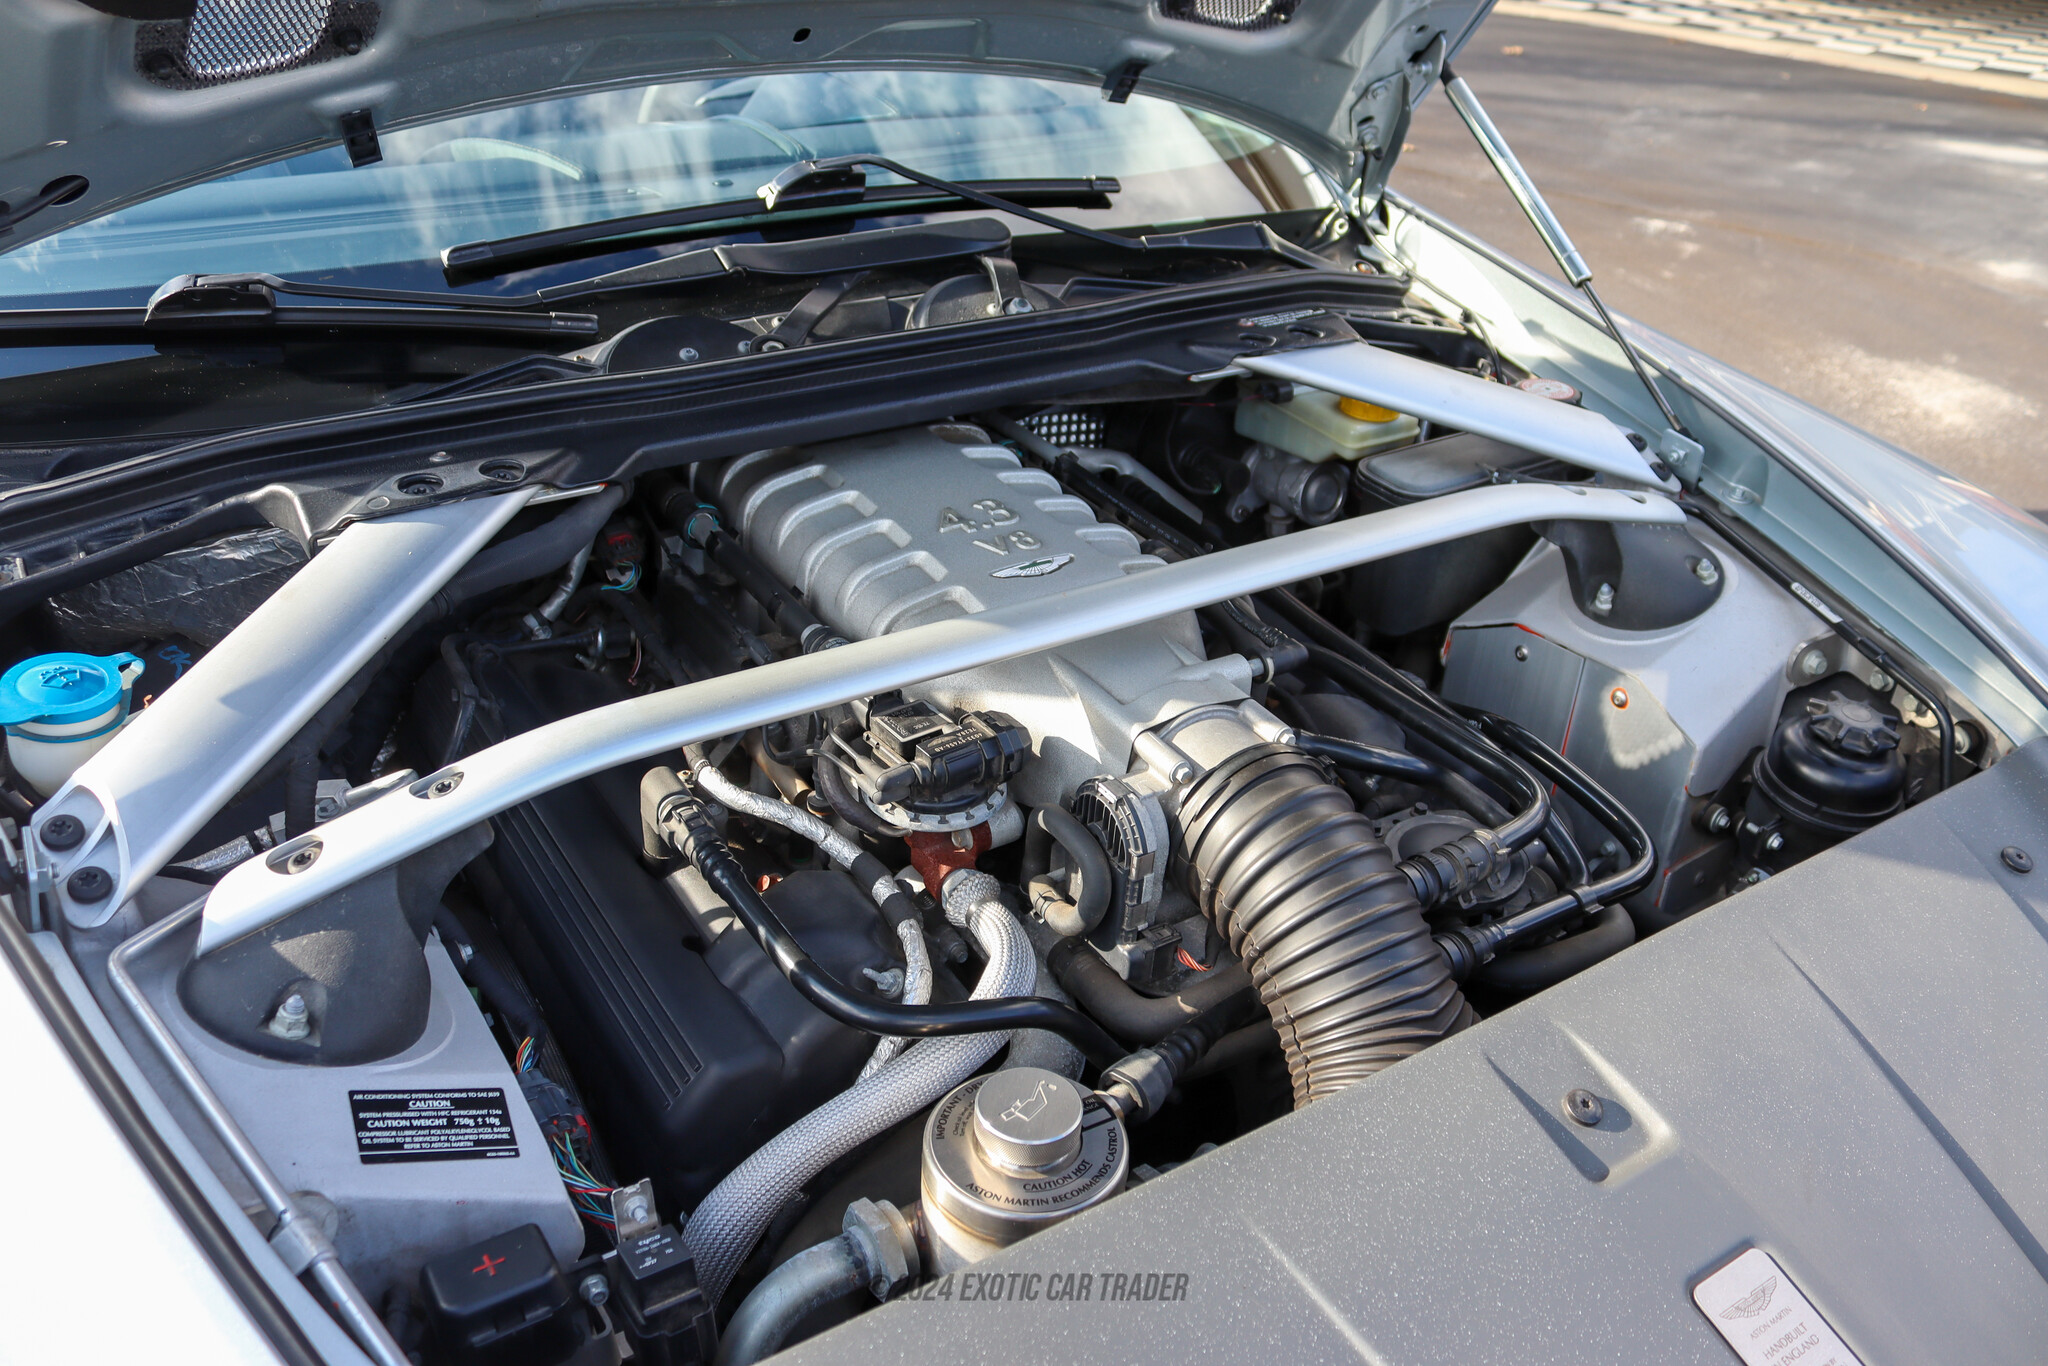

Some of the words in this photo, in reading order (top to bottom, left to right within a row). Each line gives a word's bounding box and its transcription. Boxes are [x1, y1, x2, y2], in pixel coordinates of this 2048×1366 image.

[939, 498, 1020, 534] 4.3
[972, 530, 1042, 556] V8
[409, 1100, 451, 1108] CAUTION
[936, 1095, 962, 1140] IMPORTANT
[367, 1119, 410, 1128] CAUTION
[411, 1118, 448, 1127] WEIGHT
[453, 1117, 475, 1127] 750g
[484, 1116, 501, 1126] 10g
[966, 1181, 1002, 1202] ASTON
[1004, 1196, 1050, 1206] MARTIN
[1052, 1163, 1111, 1204] RECOMMENDS
[1105, 1126, 1118, 1163] CASTROL
[1023, 1175, 1073, 1191] CAUTION
[1074, 1158, 1092, 1176] HOT
[1750, 1322, 1771, 1340] ASTON
[1769, 1306, 1793, 1325] MARTIN
[1762, 1321, 1808, 1360] HANDBUILT
[1781, 1334, 1820, 1366] ENGLAND
